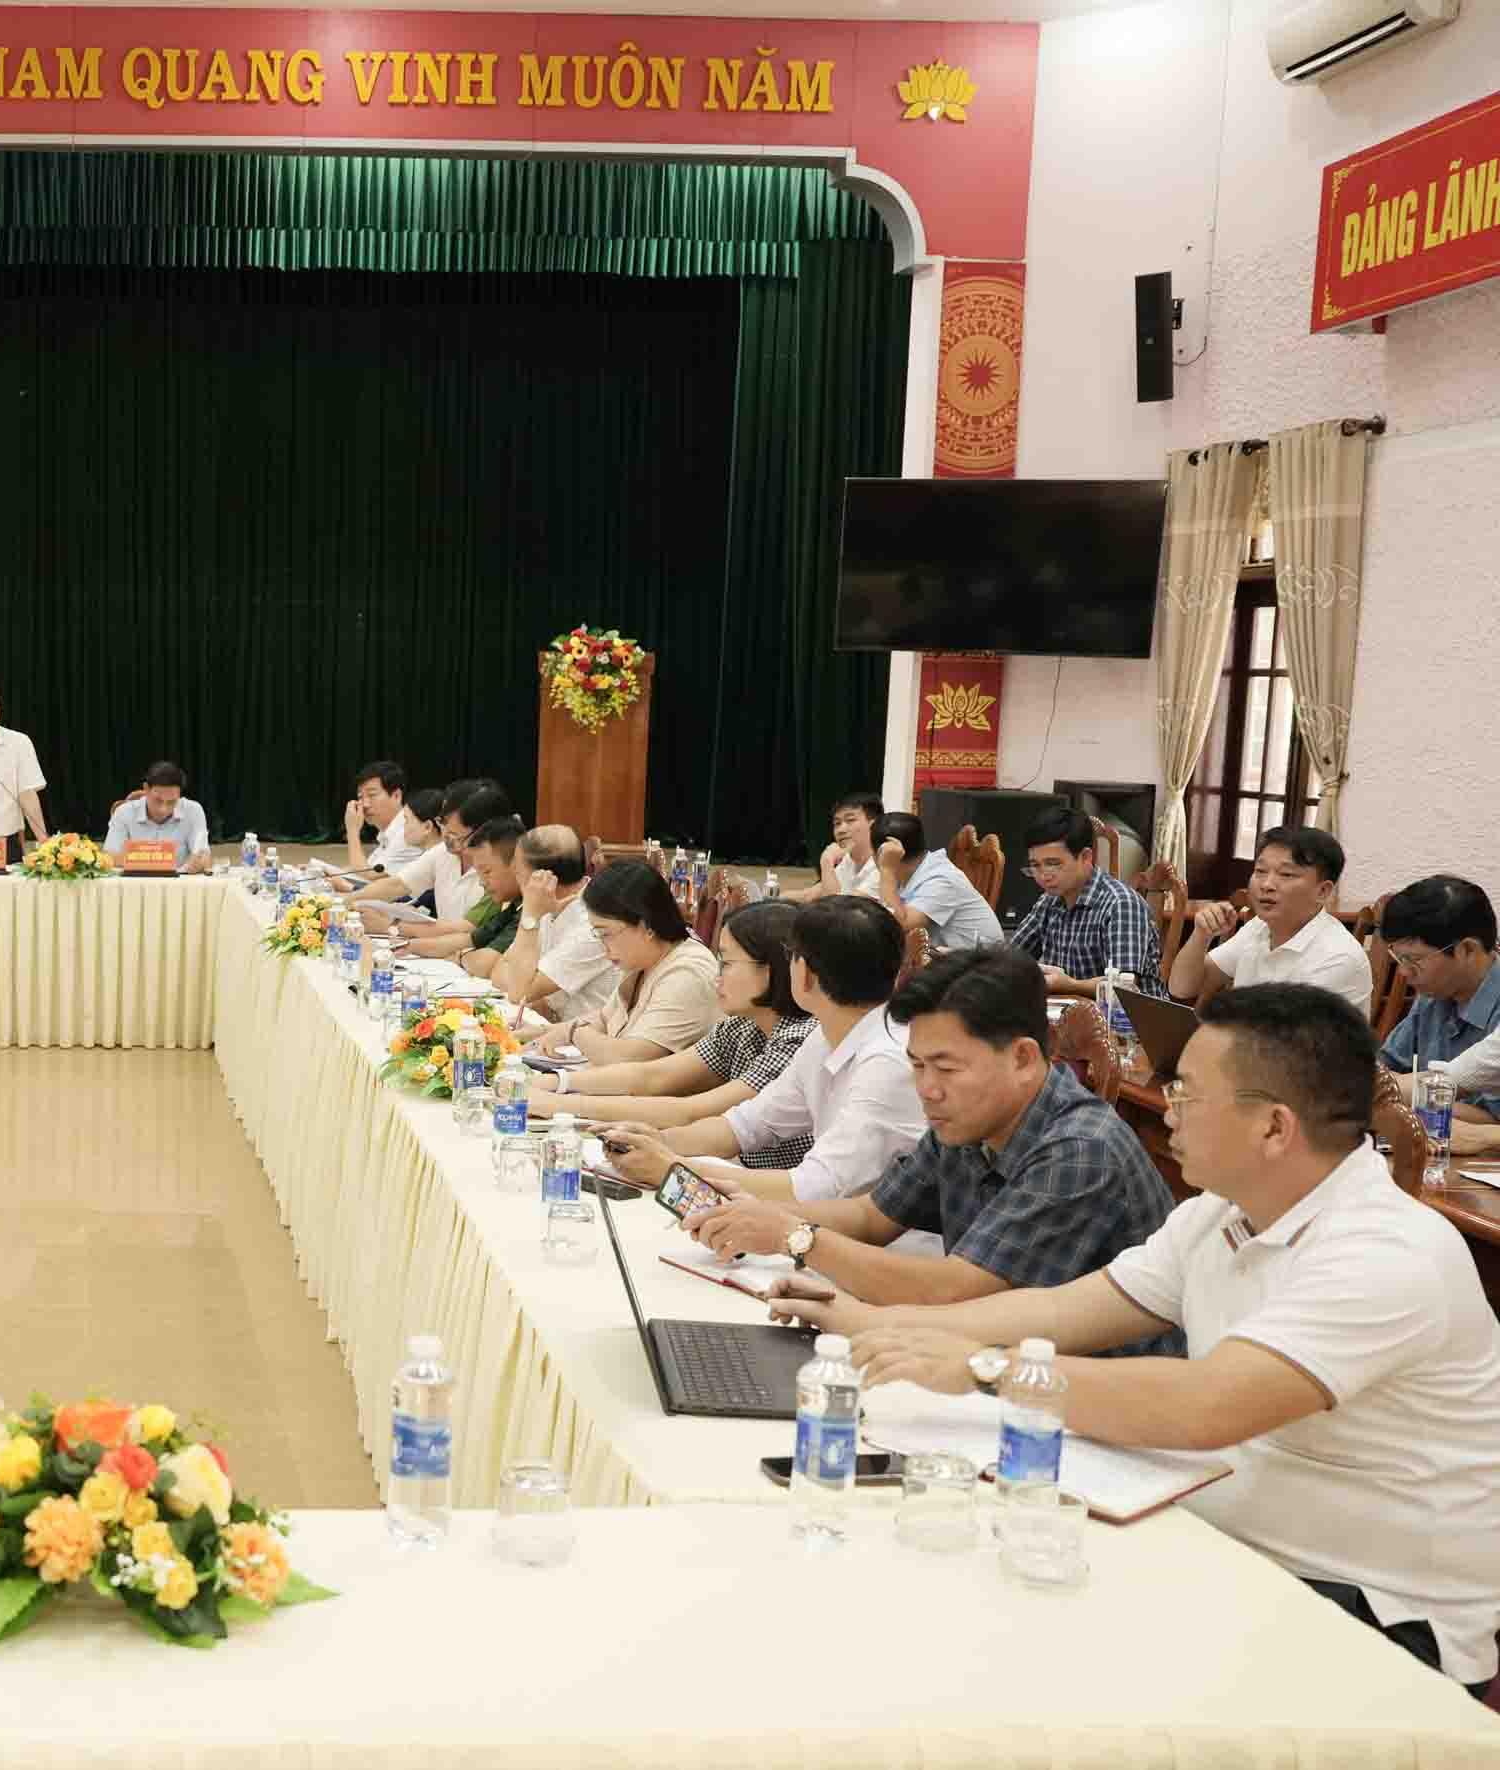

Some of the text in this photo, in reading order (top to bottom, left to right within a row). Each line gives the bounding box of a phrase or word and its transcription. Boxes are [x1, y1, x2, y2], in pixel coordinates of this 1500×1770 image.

[121, 46, 326, 108] QUANG
[344, 50, 499, 106] VINH
[518, 44, 686, 109] MUÔN
[705, 46, 835, 113] NĂM
[1340, 183, 1419, 280] ĐẢNG
